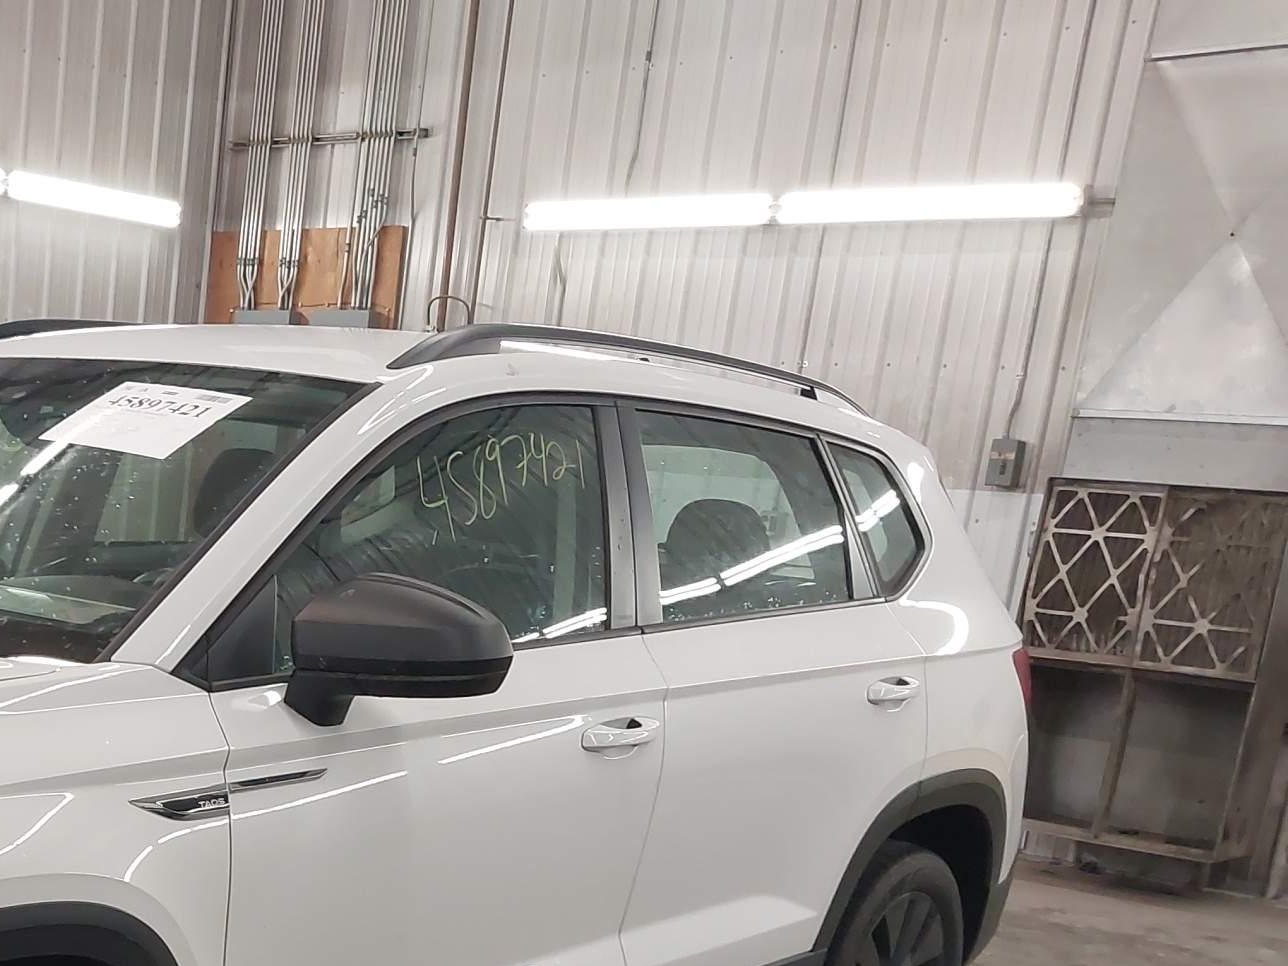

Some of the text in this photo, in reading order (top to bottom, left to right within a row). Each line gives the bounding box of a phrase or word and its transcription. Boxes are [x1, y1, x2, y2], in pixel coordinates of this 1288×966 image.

[109, 395, 212, 418] 45897421
[416, 432, 586, 543] 45897421
[198, 797, 226, 809] TAOS
